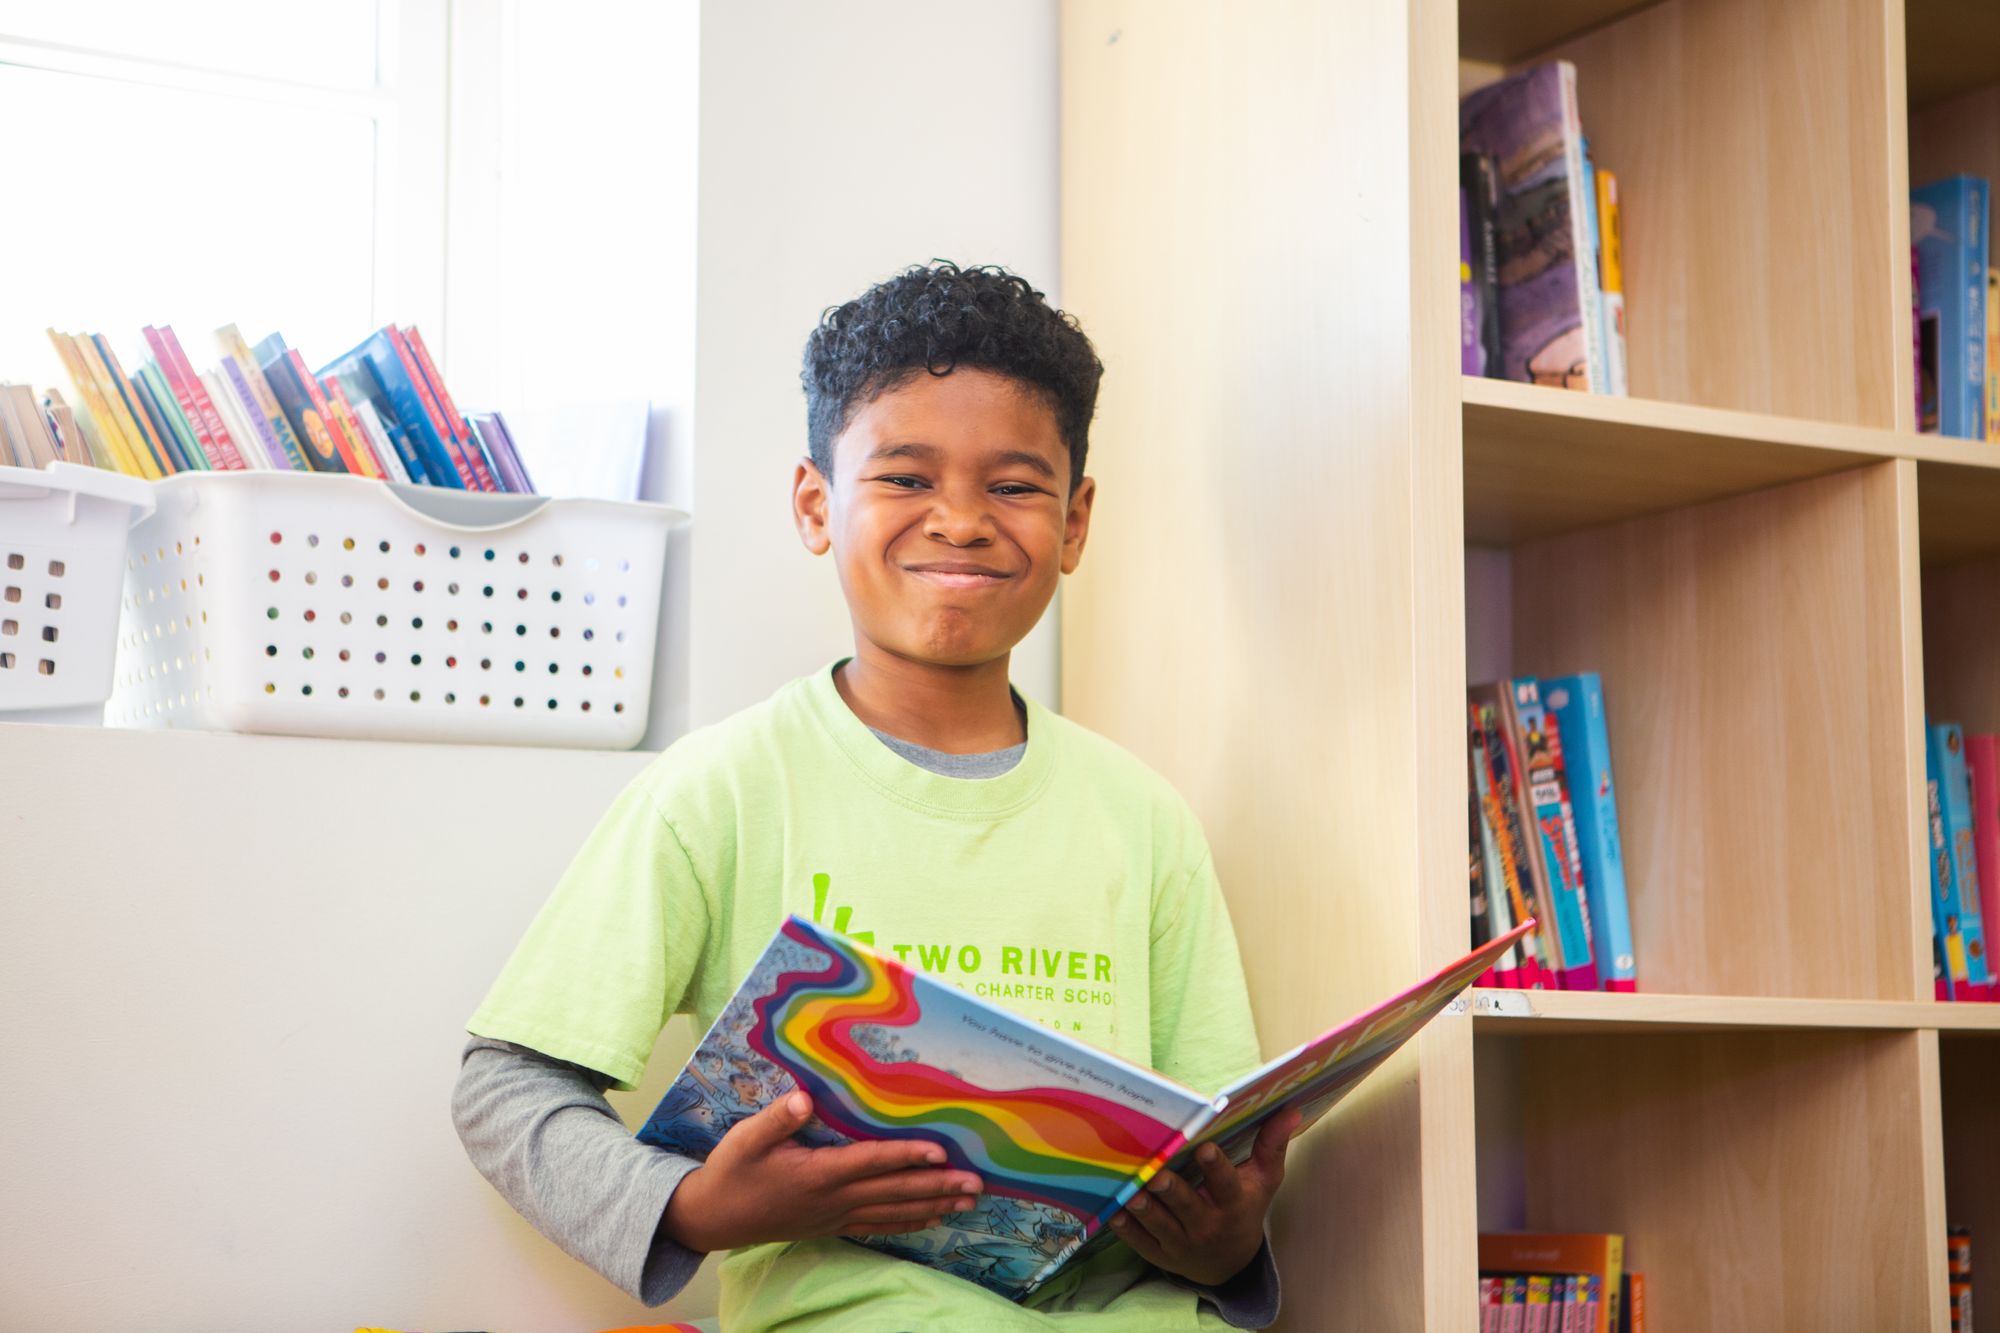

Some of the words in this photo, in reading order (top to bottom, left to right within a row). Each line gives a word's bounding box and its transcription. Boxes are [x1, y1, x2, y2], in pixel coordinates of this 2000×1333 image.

[893, 944, 982, 973] TWO
[1002, 945, 1116, 983] RIVER
[975, 982, 1055, 1001] CHARTER
[1064, 988, 1113, 1006] SCHO
